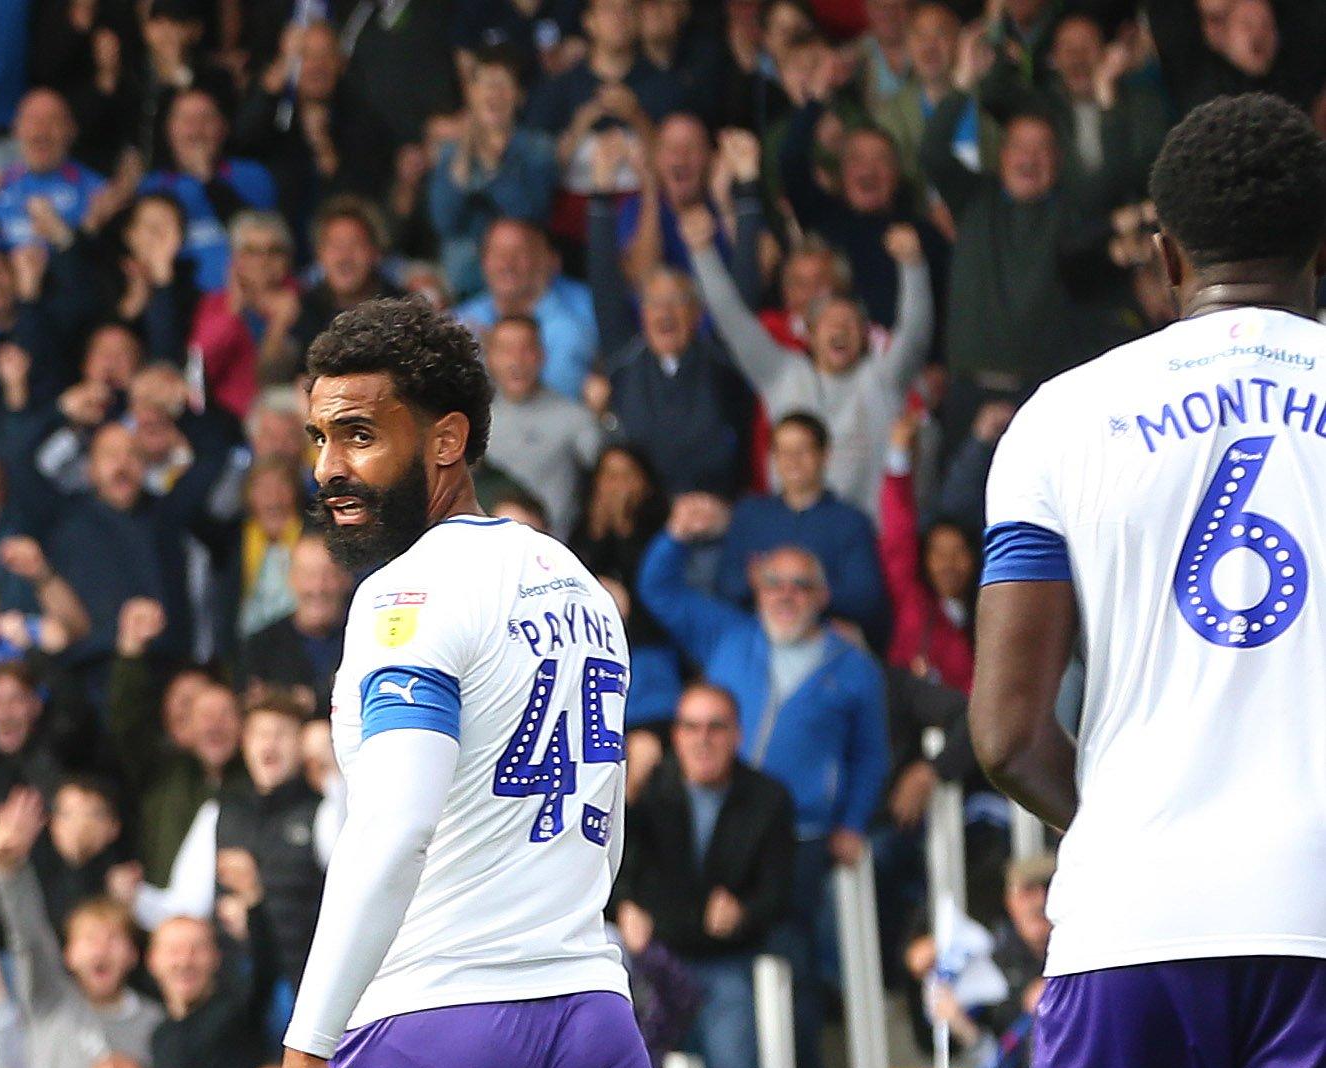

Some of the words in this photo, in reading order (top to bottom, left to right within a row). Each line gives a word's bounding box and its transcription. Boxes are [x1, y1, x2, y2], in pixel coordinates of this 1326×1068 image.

[520, 602, 617, 657] PAYNE
[1174, 434, 1308, 649] 6
[493, 657, 629, 848] 45
